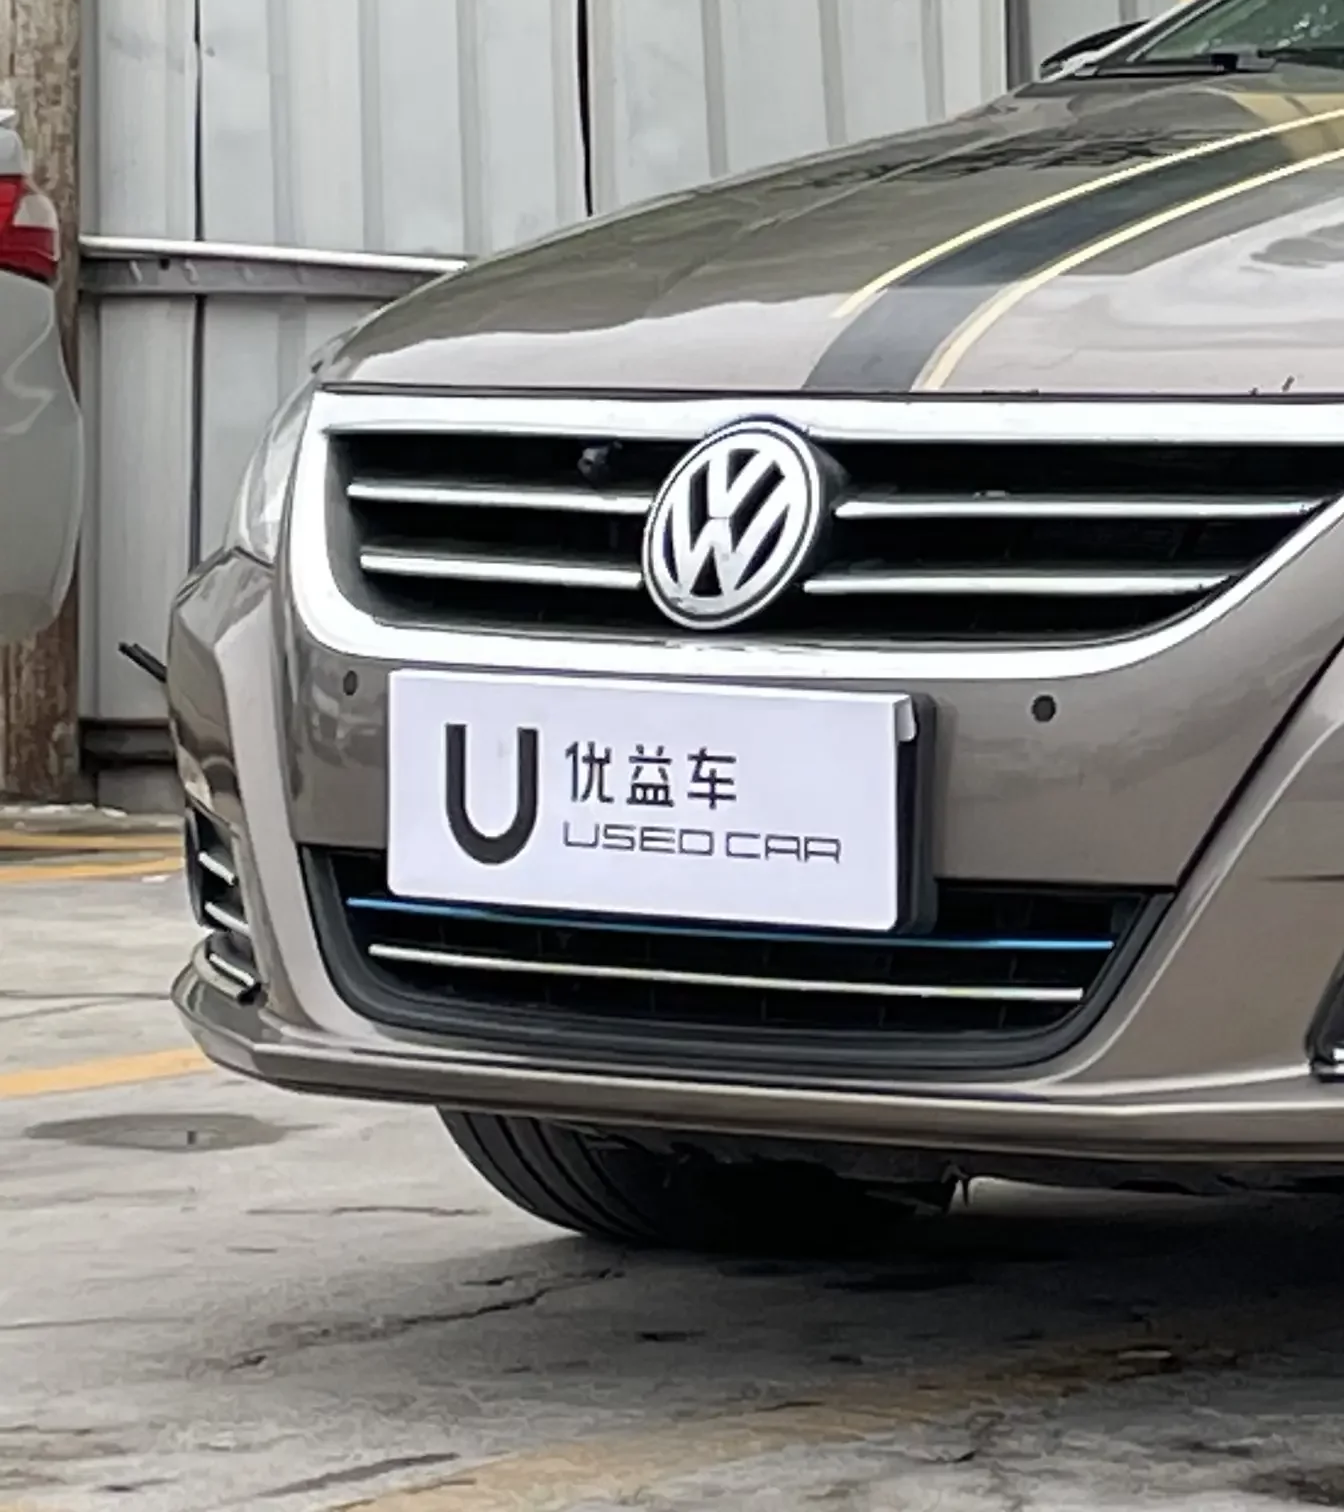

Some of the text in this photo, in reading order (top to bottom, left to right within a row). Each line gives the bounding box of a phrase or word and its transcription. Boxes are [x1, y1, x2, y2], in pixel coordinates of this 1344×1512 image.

[445, 723, 539, 865] U
[564, 741, 738, 810] 优益车
[563, 821, 842, 864] USED CAR
